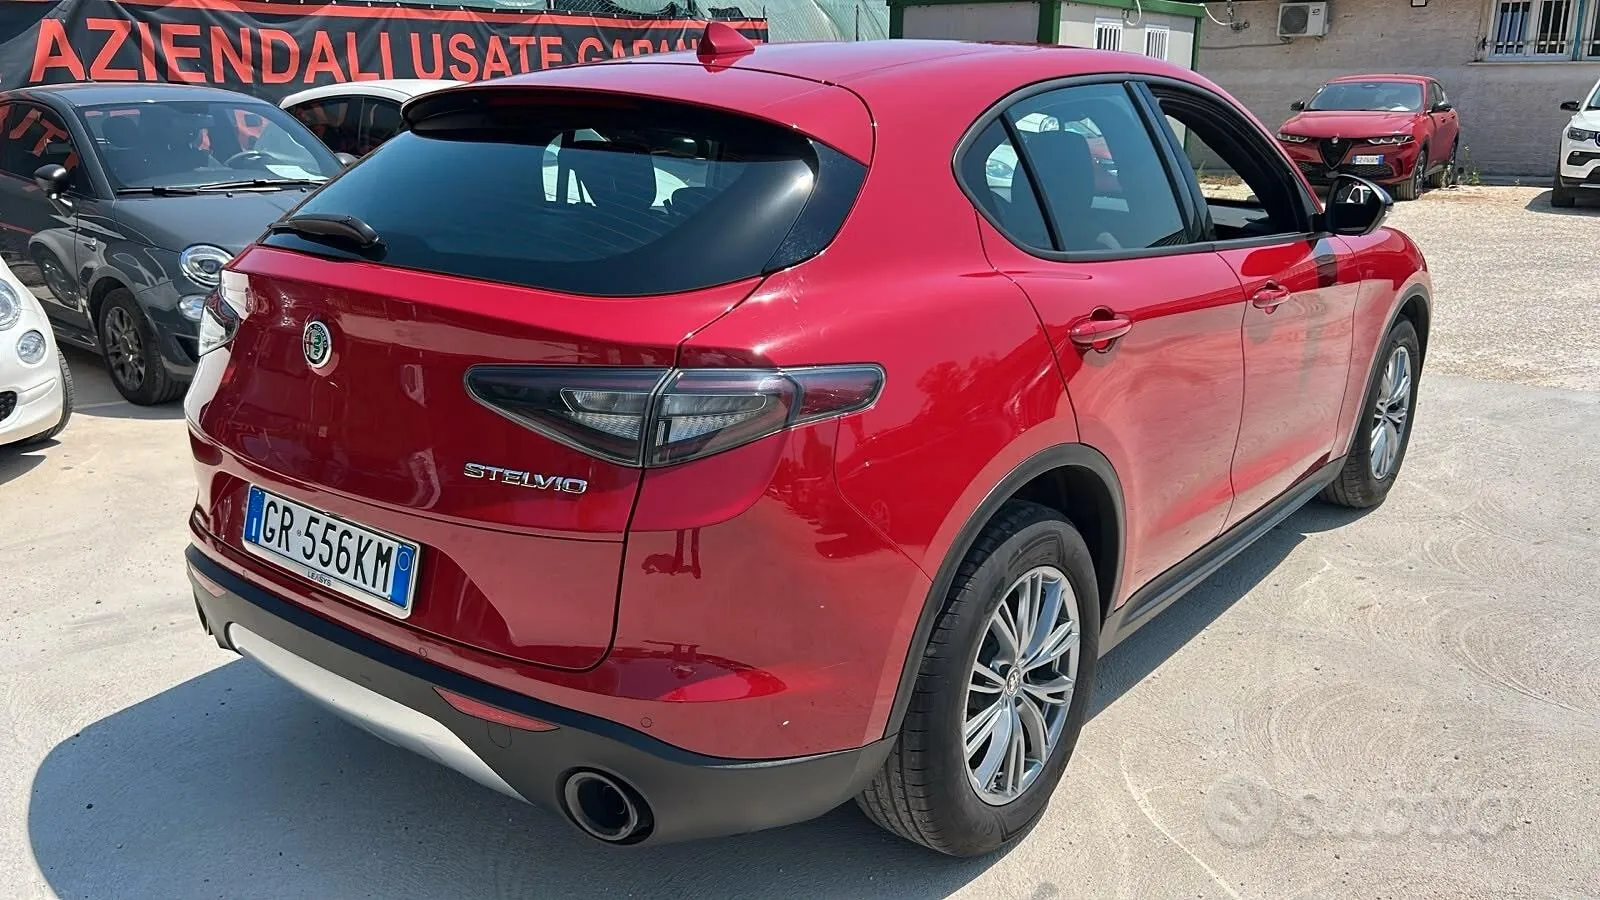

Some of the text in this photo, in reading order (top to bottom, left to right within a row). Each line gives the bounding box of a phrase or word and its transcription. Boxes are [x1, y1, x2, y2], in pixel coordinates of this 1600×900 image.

[29, 17, 394, 84] AZIENDALI
[410, 32, 563, 83] USATE
[463, 462, 588, 494] STELVIO
[307, 570, 332, 587] LEASYS
